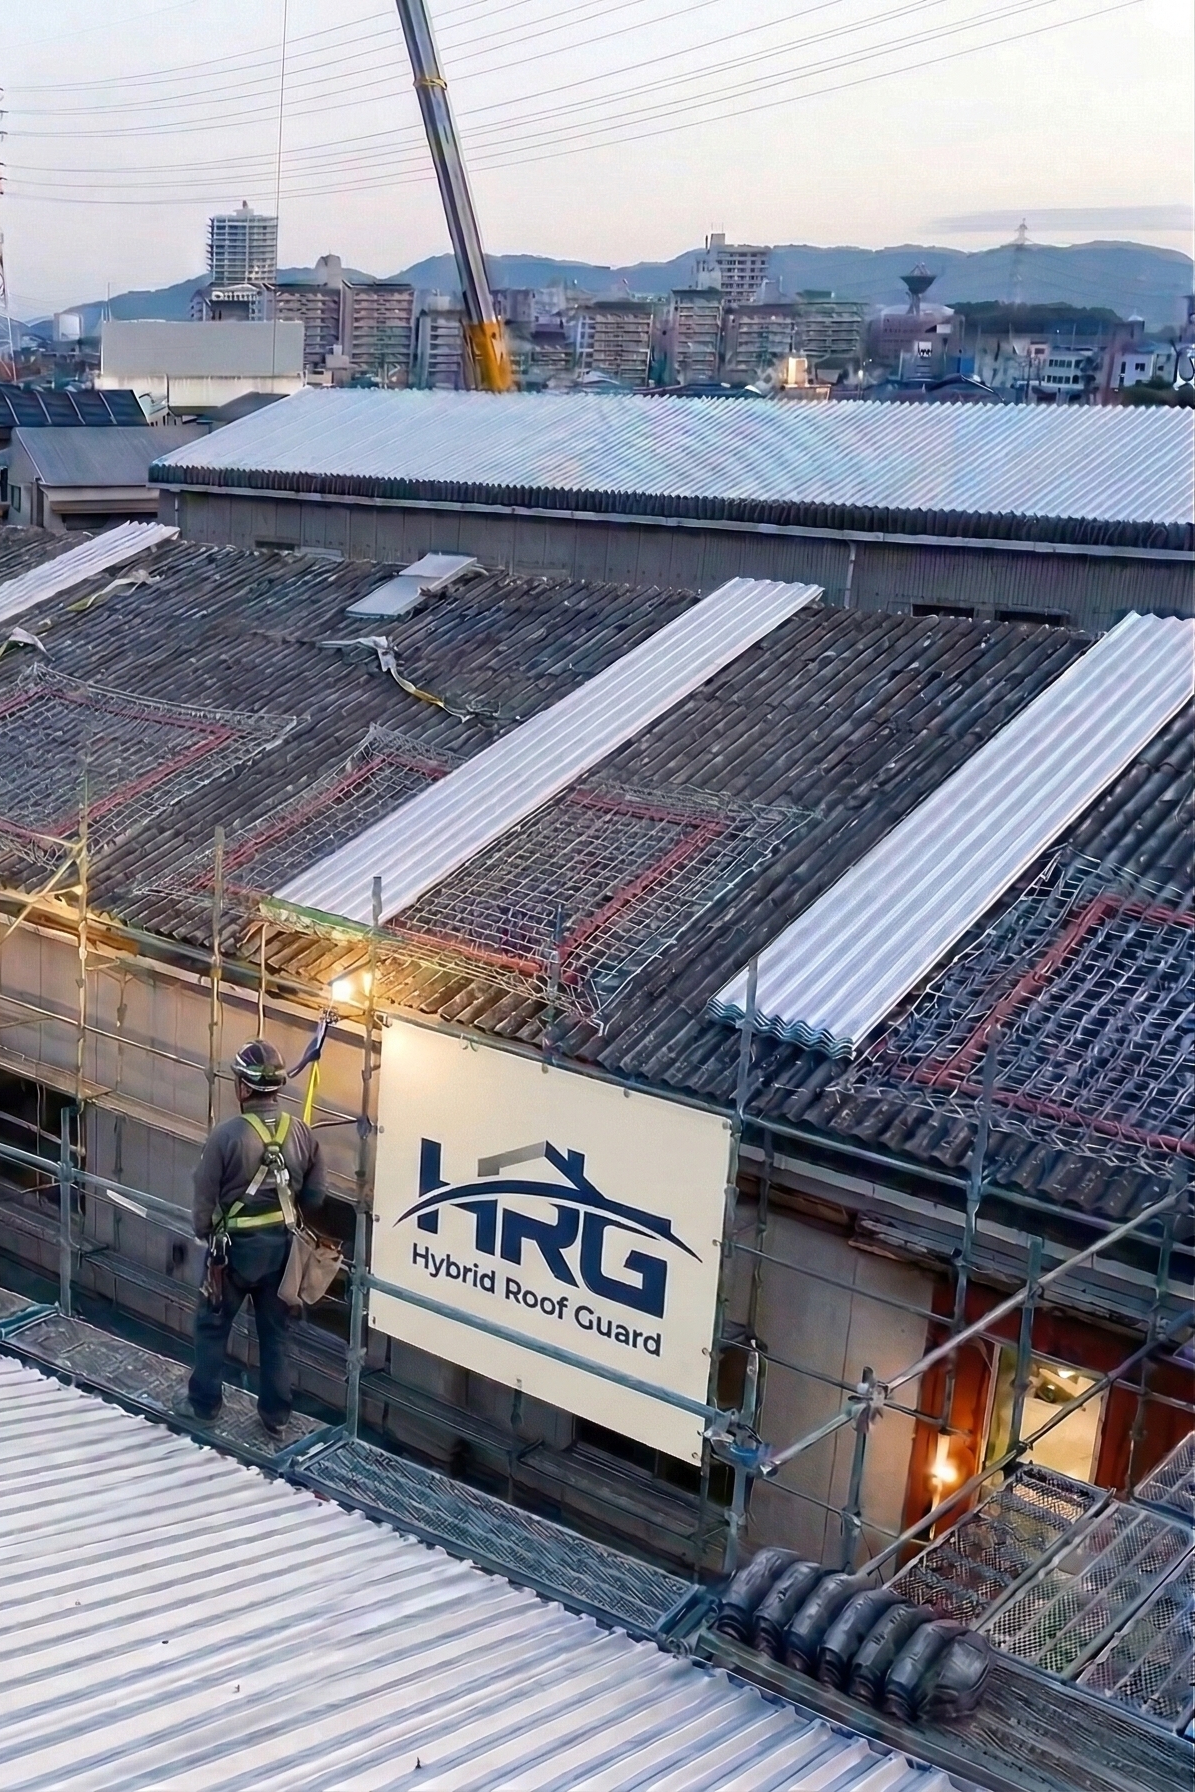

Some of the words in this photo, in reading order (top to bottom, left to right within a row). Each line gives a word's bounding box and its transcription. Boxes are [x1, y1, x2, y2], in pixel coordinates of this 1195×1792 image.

[412, 1242, 496, 1295] Hybrid
[504, 1276, 569, 1320] Roof
[574, 1304, 662, 1358] Guard
[417, 1137, 668, 1320] HRG
